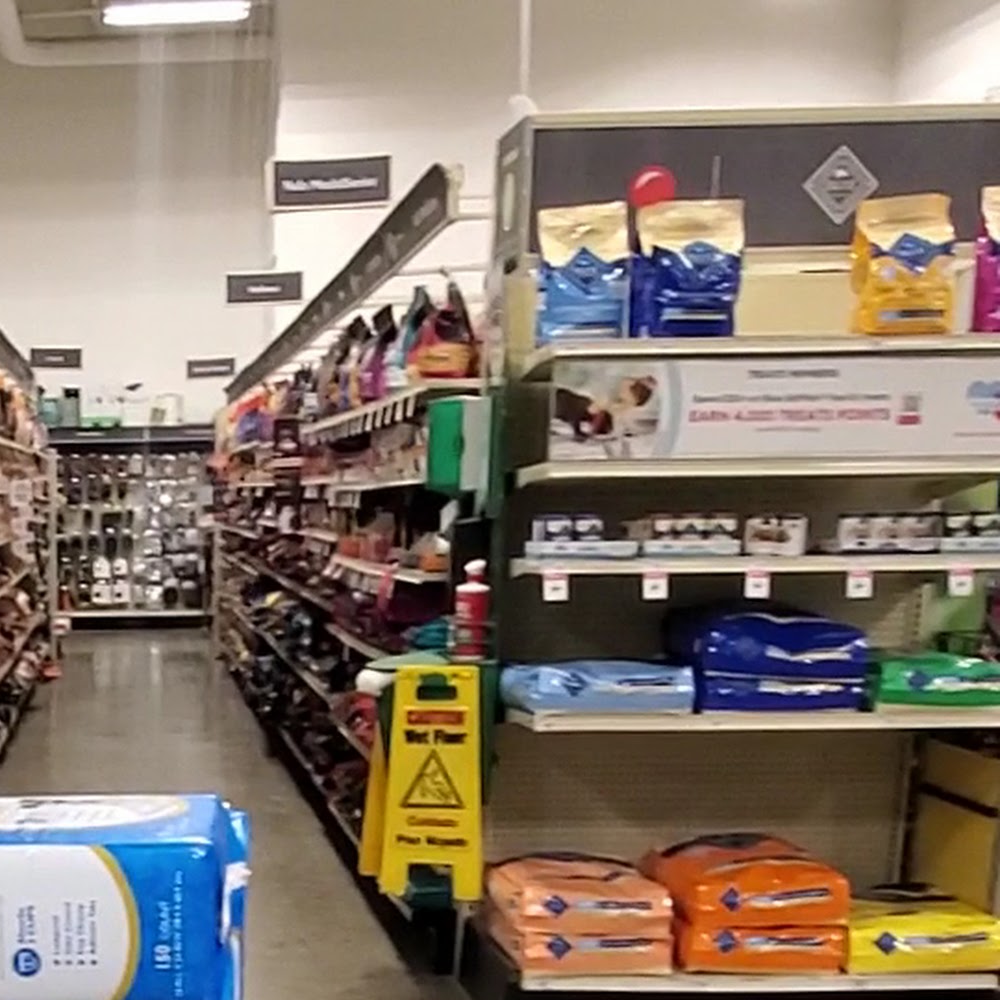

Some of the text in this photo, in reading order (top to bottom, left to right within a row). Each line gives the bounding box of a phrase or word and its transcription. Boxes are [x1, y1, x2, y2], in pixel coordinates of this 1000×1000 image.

[405, 730, 467, 744] Wet Floor
[154, 900, 172, 969] 150 COUNT
